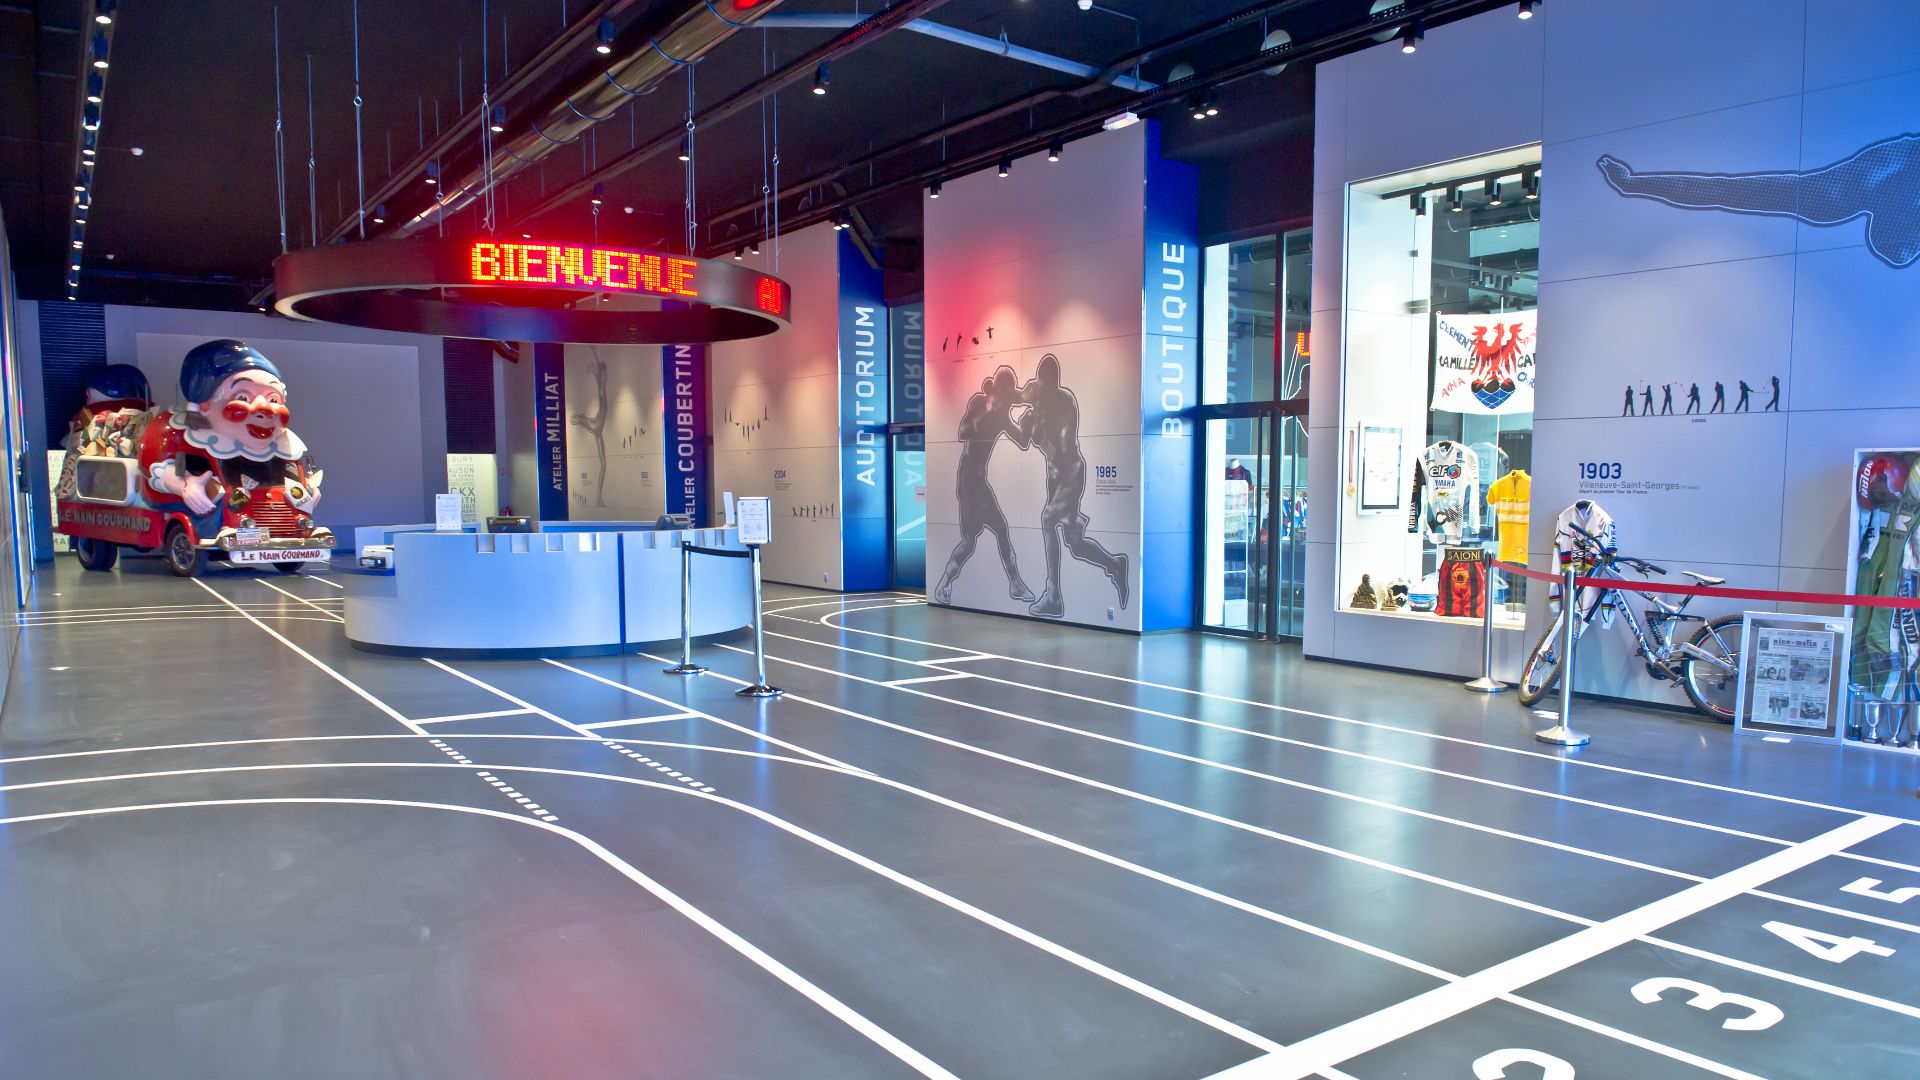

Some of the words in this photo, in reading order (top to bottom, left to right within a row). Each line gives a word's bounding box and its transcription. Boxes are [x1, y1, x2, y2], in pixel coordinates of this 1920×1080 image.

[471, 242, 697, 297] BIENVENUE
[1161, 242, 1187, 439] BOUTIQUE
[545, 373, 561, 442] MILLIAT
[675, 344, 694, 472] COUBERTIN
[856, 306, 875, 487] AUDITORIUM
[553, 446, 562, 491] ATELIER
[1096, 466, 1117, 478] 1985
[1429, 465, 1449, 478] elf
[1578, 462, 1622, 480] 1903
[1579, 481, 1680, 491] Villeneuve-Saint-Georges
[74, 510, 95, 524] NAIN
[97, 513, 151, 532] GOURMAND
[259, 551, 280, 561] NAIN
[281, 549, 321, 560] GOURMAND
[1773, 638, 1818, 647] nice-matin
[1761, 920, 1897, 963] 4
[1630, 976, 1785, 1031] 3
